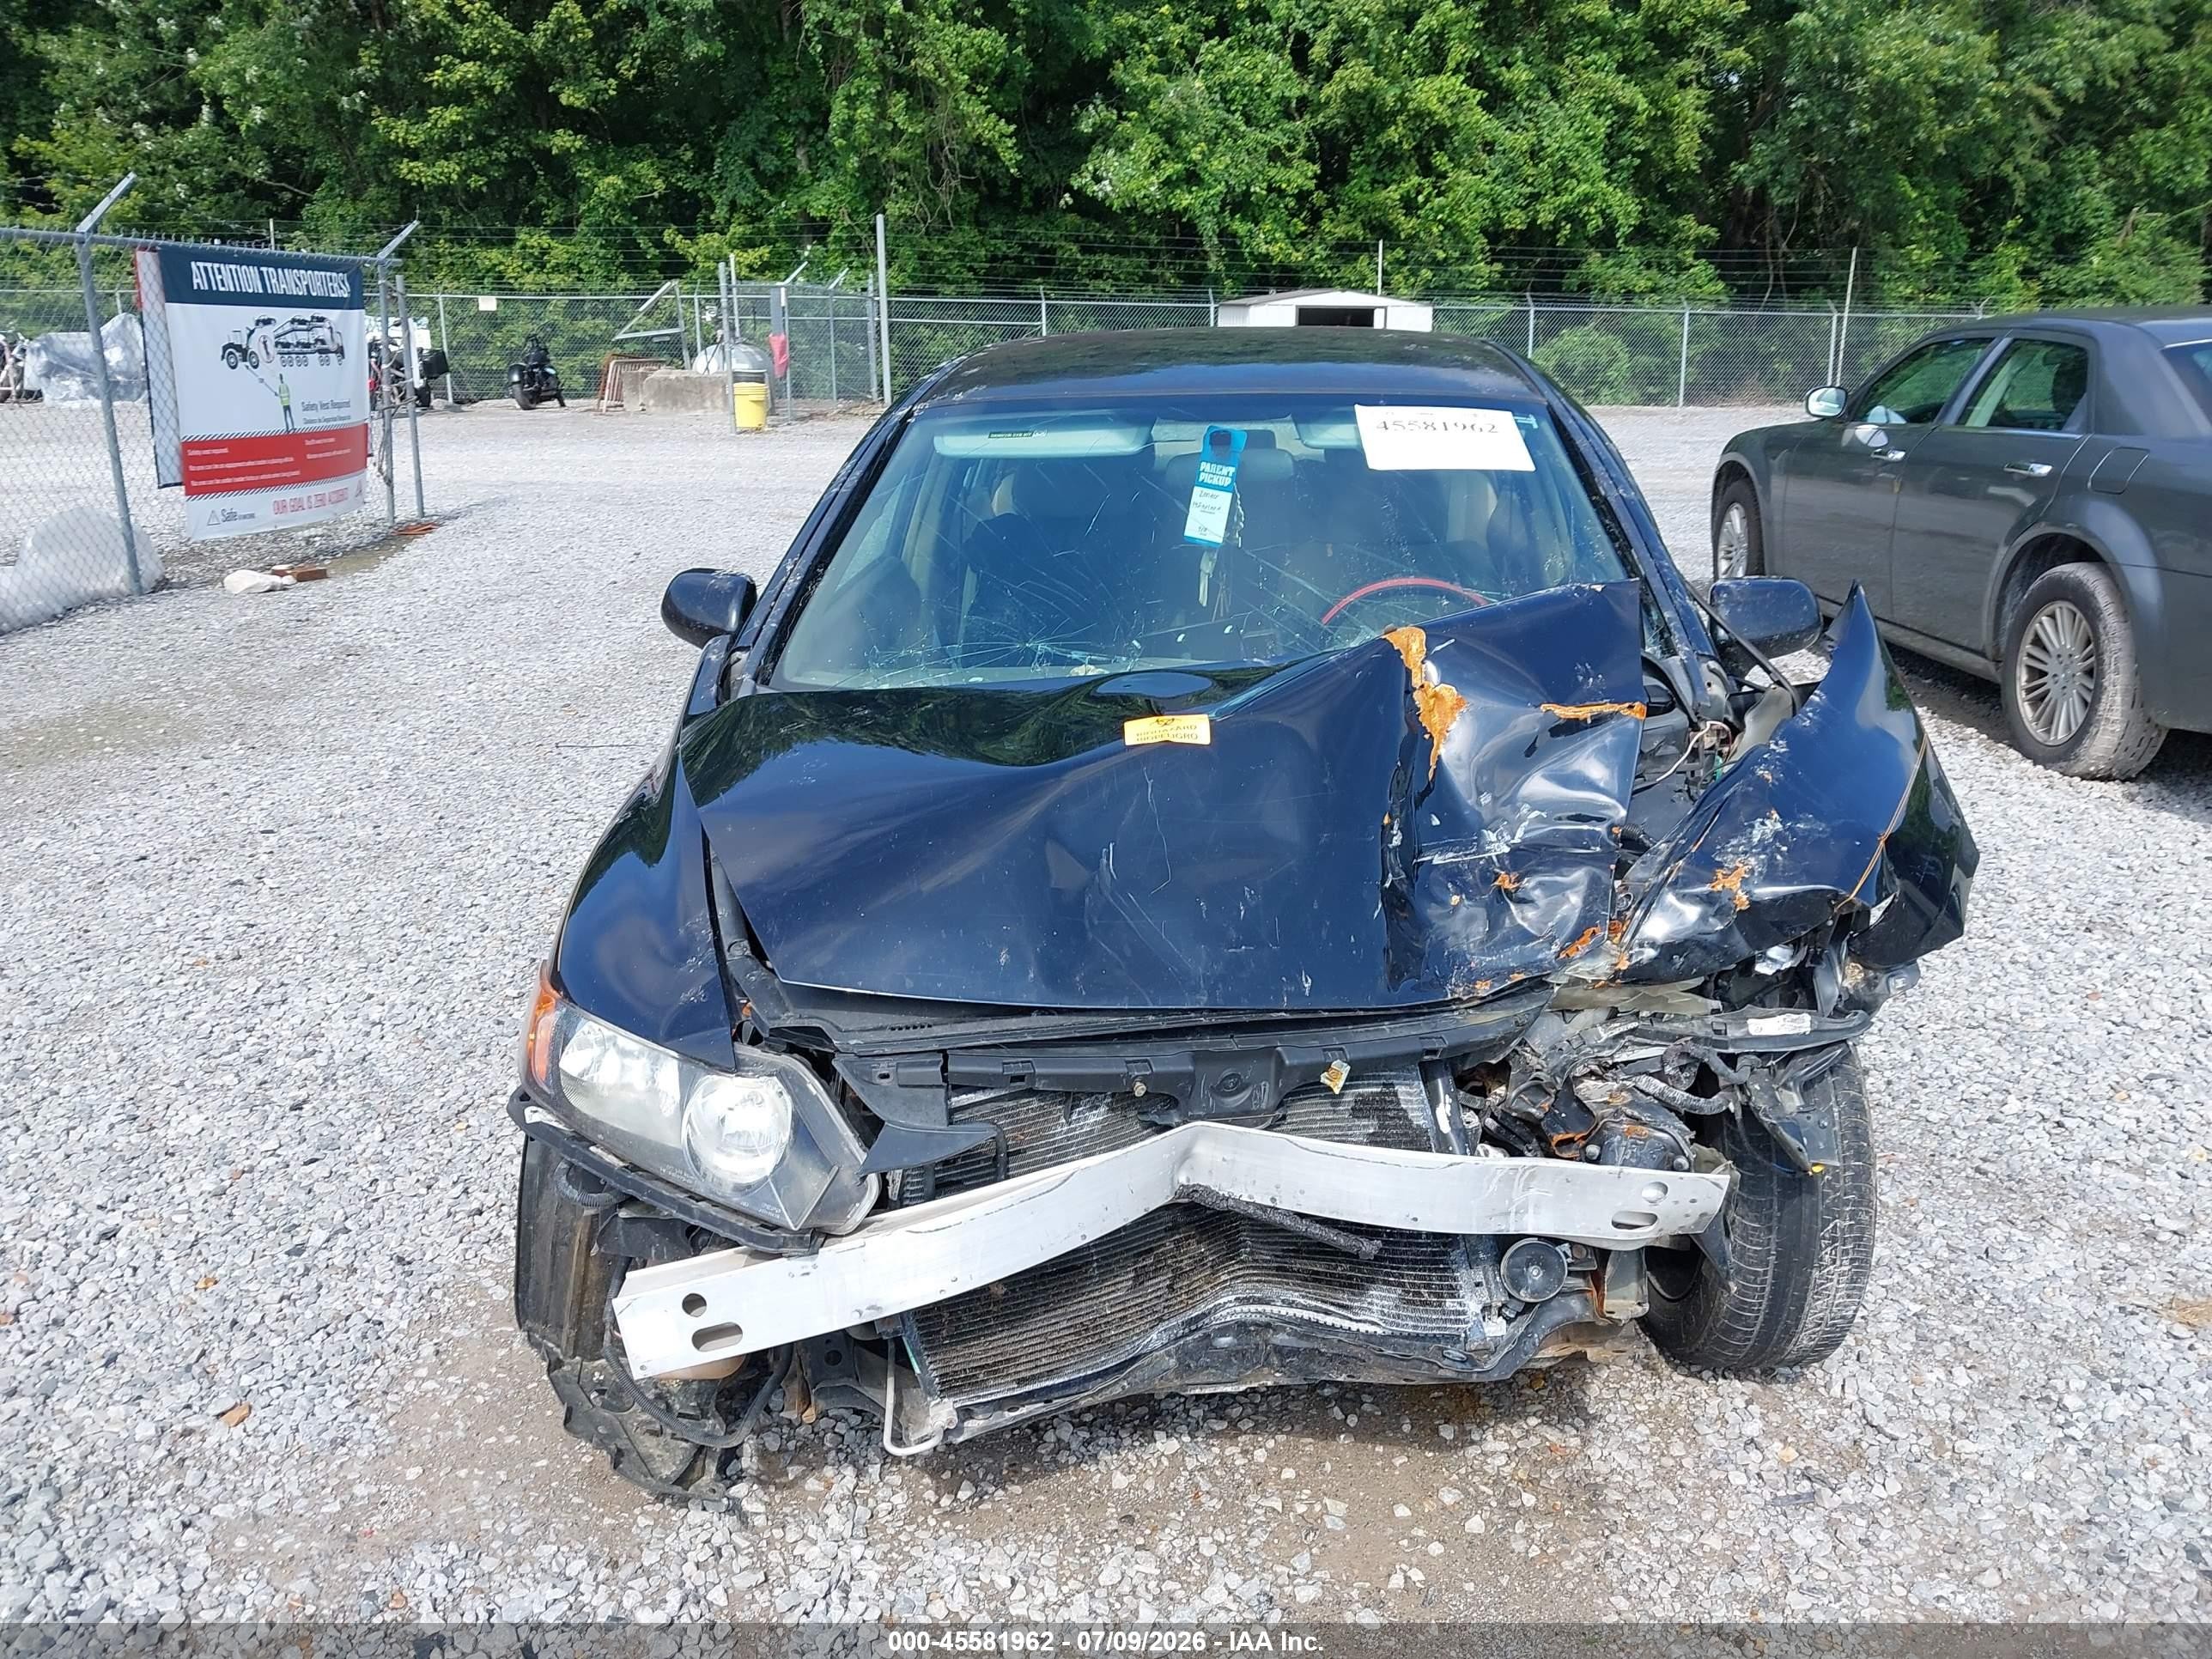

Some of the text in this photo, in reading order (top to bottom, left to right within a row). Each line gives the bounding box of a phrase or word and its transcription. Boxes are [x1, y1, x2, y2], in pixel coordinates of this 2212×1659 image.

[191, 261, 350, 297] ATTENTION TRANSPORTERS!
[1376, 420, 1498, 434] 45581962
[1200, 461, 1236, 477] PARENT
[1198, 471, 1232, 487] PICKUP
